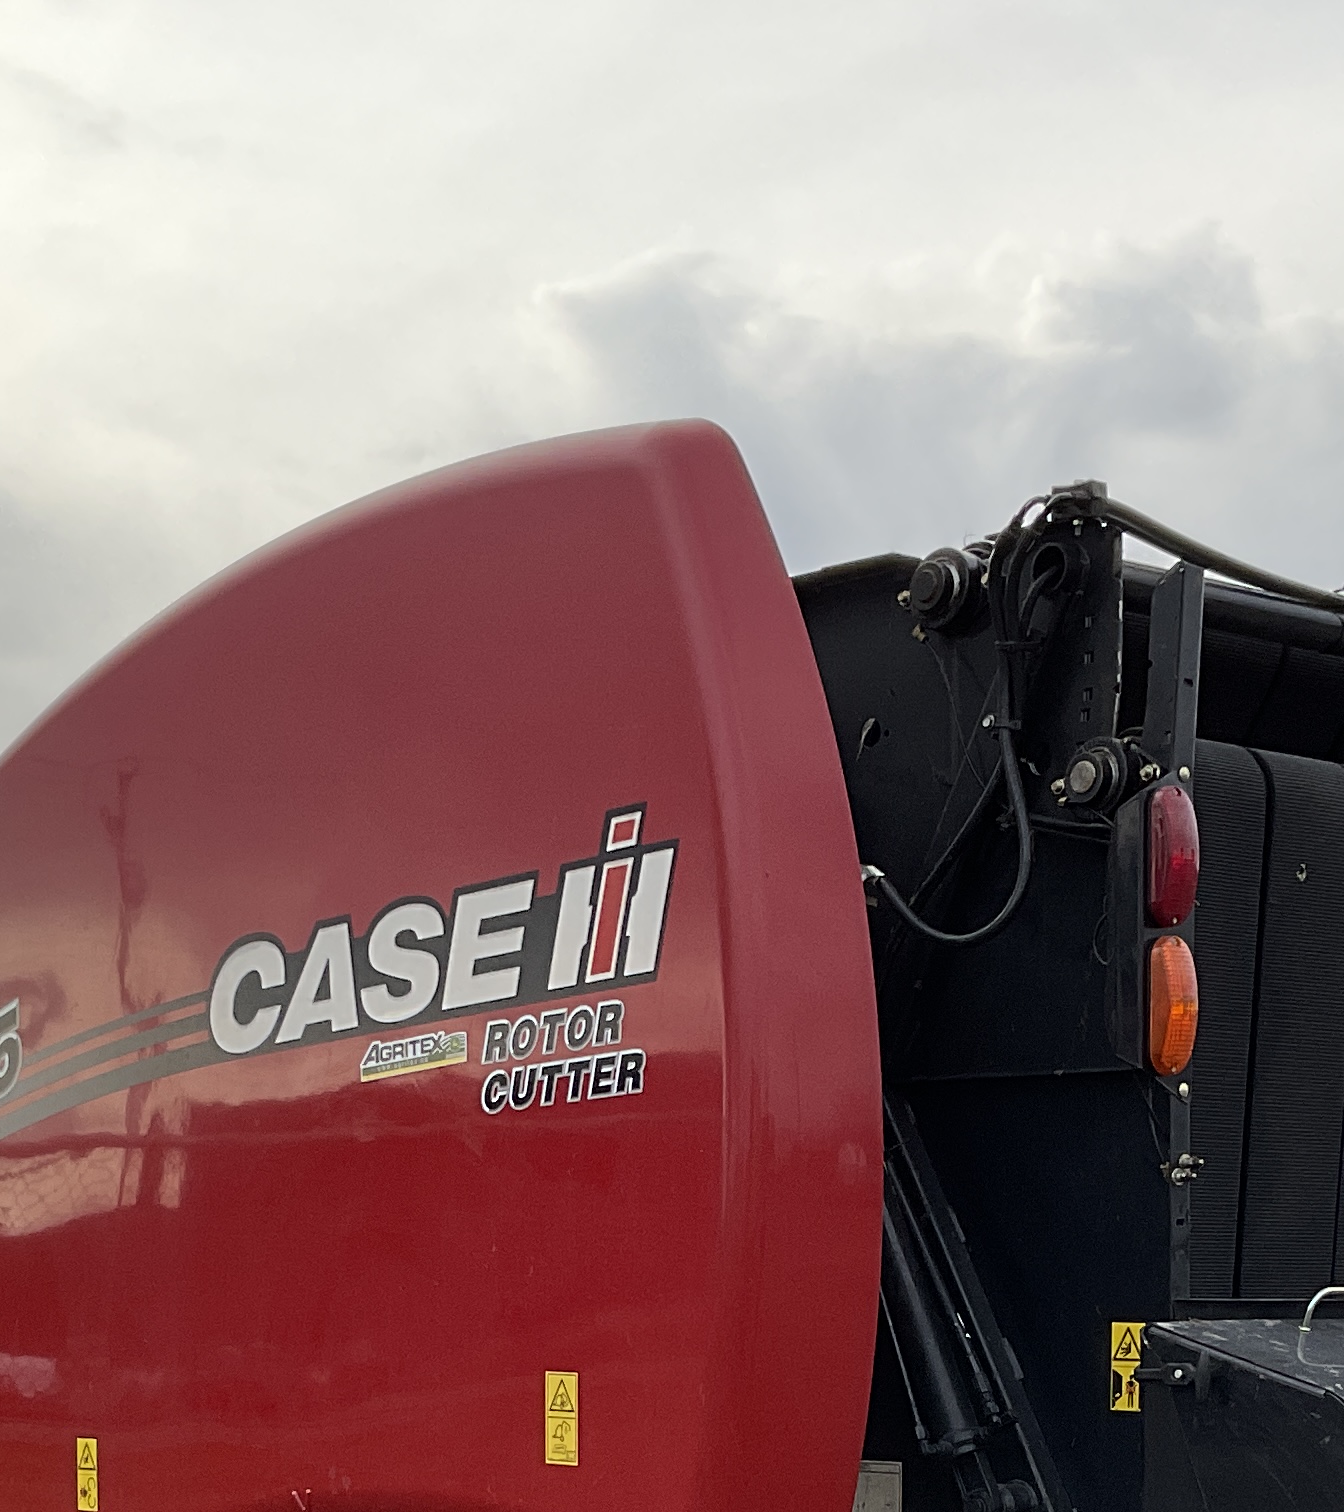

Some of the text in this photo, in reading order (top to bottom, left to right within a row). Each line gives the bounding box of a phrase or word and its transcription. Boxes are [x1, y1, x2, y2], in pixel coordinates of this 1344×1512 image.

[209, 879, 535, 1053] CASE
[362, 1031, 444, 1065] AGRITEX
[481, 1000, 625, 1065] ROTOR
[481, 1049, 646, 1114] CUTTER
